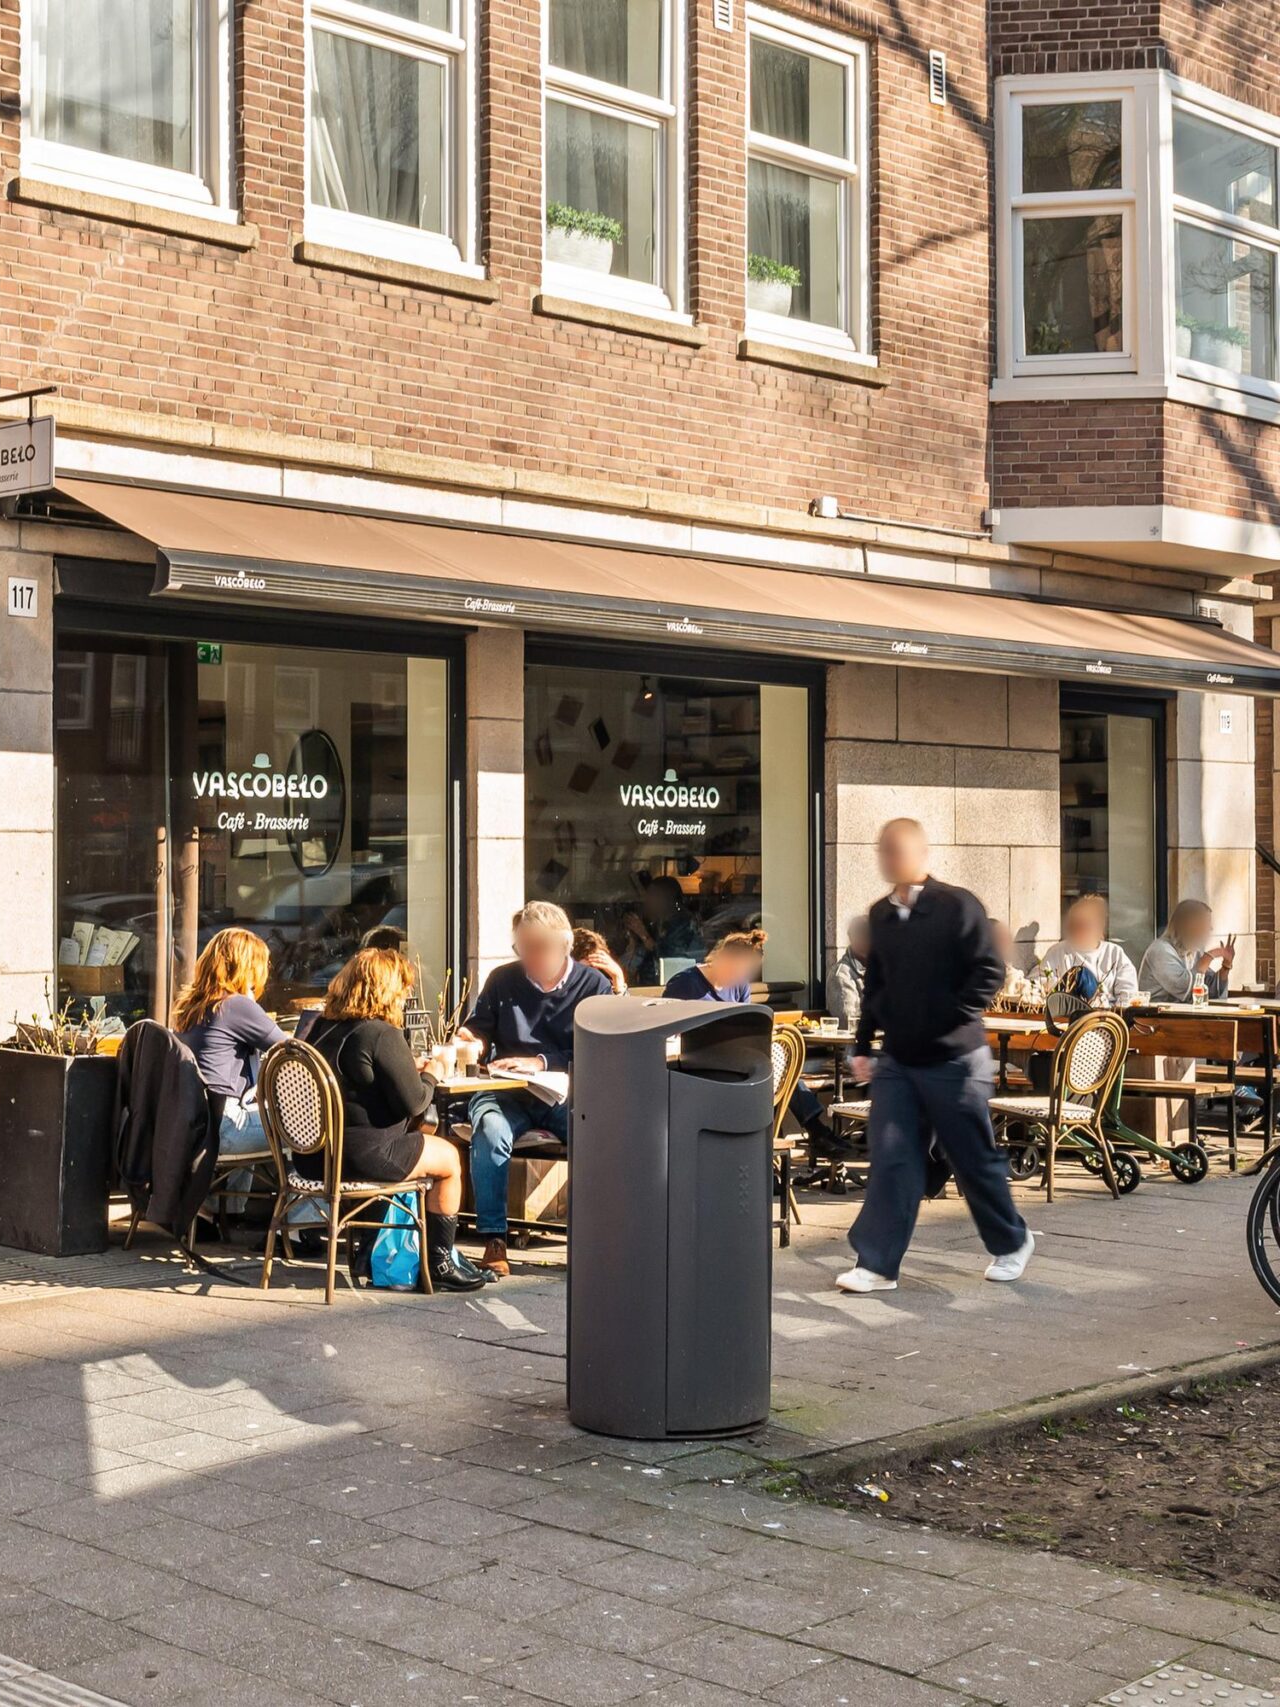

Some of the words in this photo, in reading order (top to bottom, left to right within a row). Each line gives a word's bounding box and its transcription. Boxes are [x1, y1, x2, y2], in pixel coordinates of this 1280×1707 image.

[214, 575, 266, 590] VASCOBELO
[12, 585, 34, 610] 117
[192, 771, 328, 800] VASCOBELO
[619, 784, 720, 810] VASCOBELO
[217, 812, 245, 832] Café
[254, 812, 310, 831] Brasserie
[637, 818, 659, 837] Café
[664, 819, 707, 836] Brasserie
